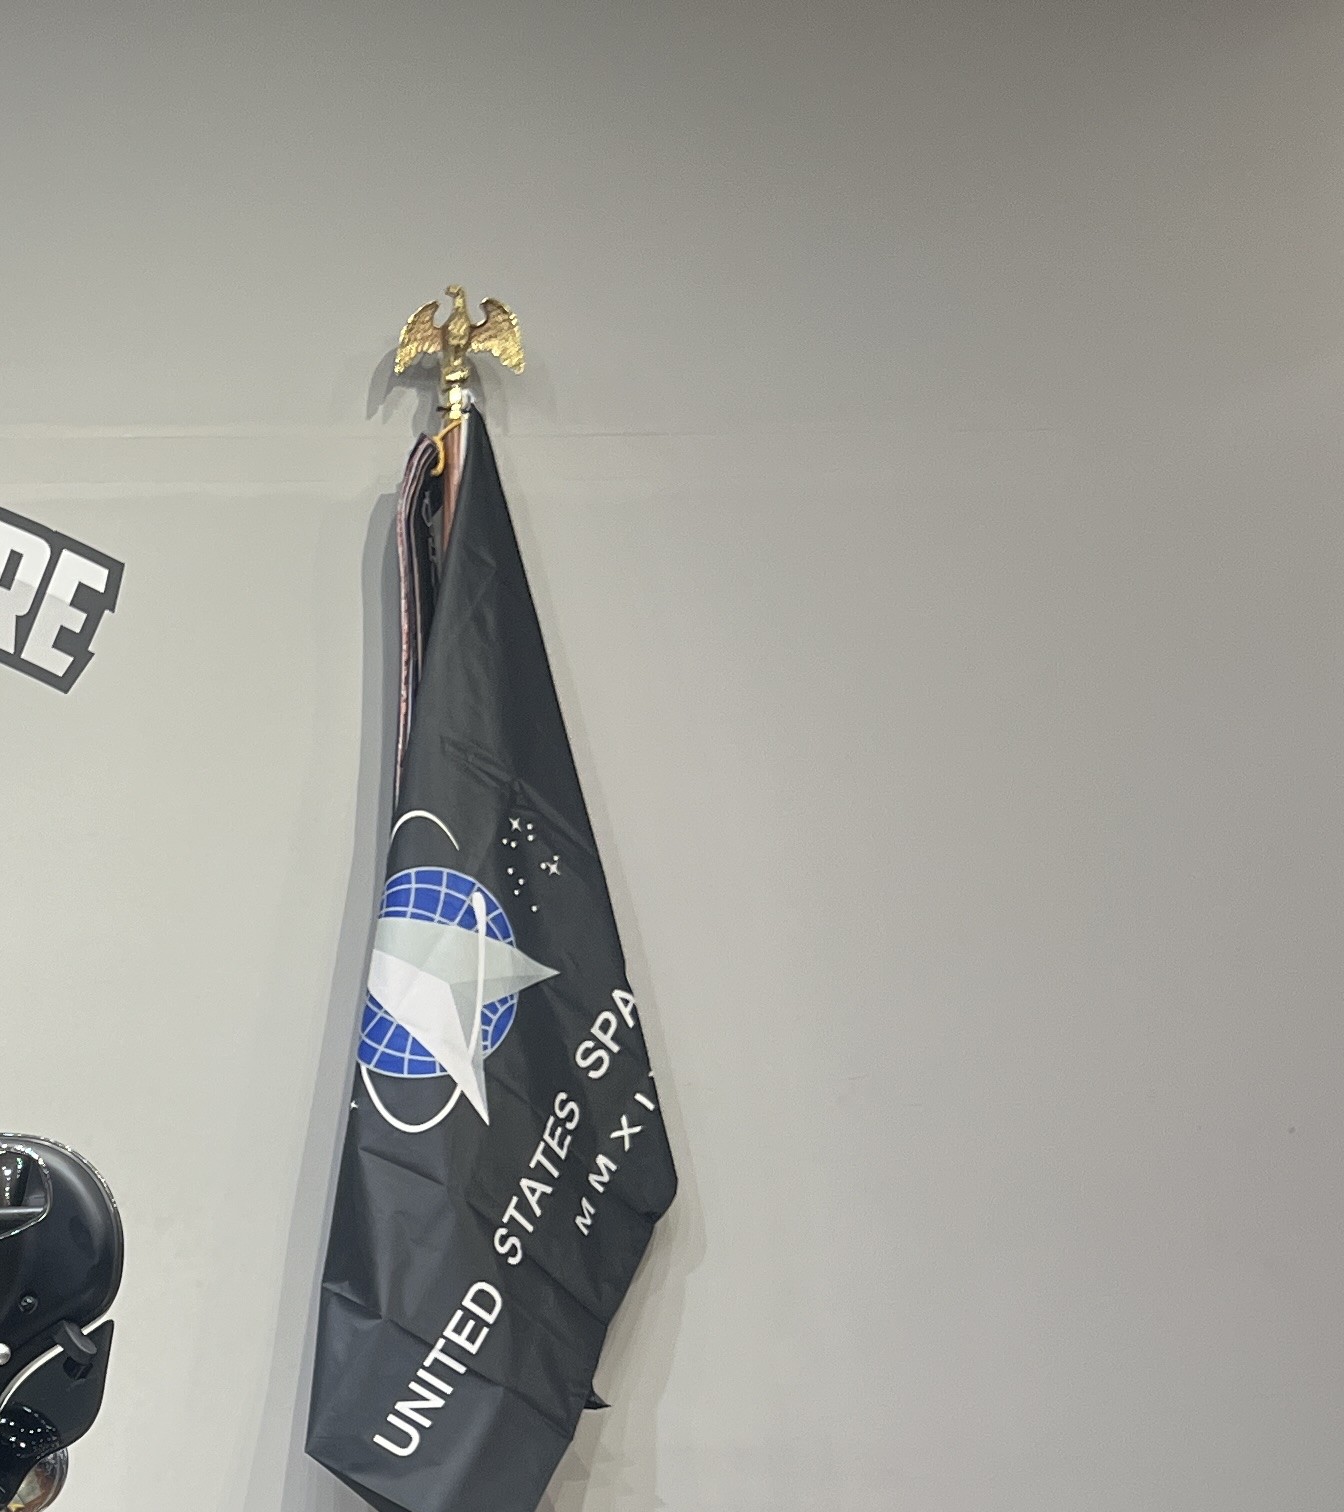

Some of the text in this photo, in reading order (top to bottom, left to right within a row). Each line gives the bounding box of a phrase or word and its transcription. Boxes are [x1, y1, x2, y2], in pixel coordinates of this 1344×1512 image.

[372, 1281, 503, 1457] UNITED
[493, 1091, 580, 1265] STATES
[574, 1070, 655, 1237] MMXI
